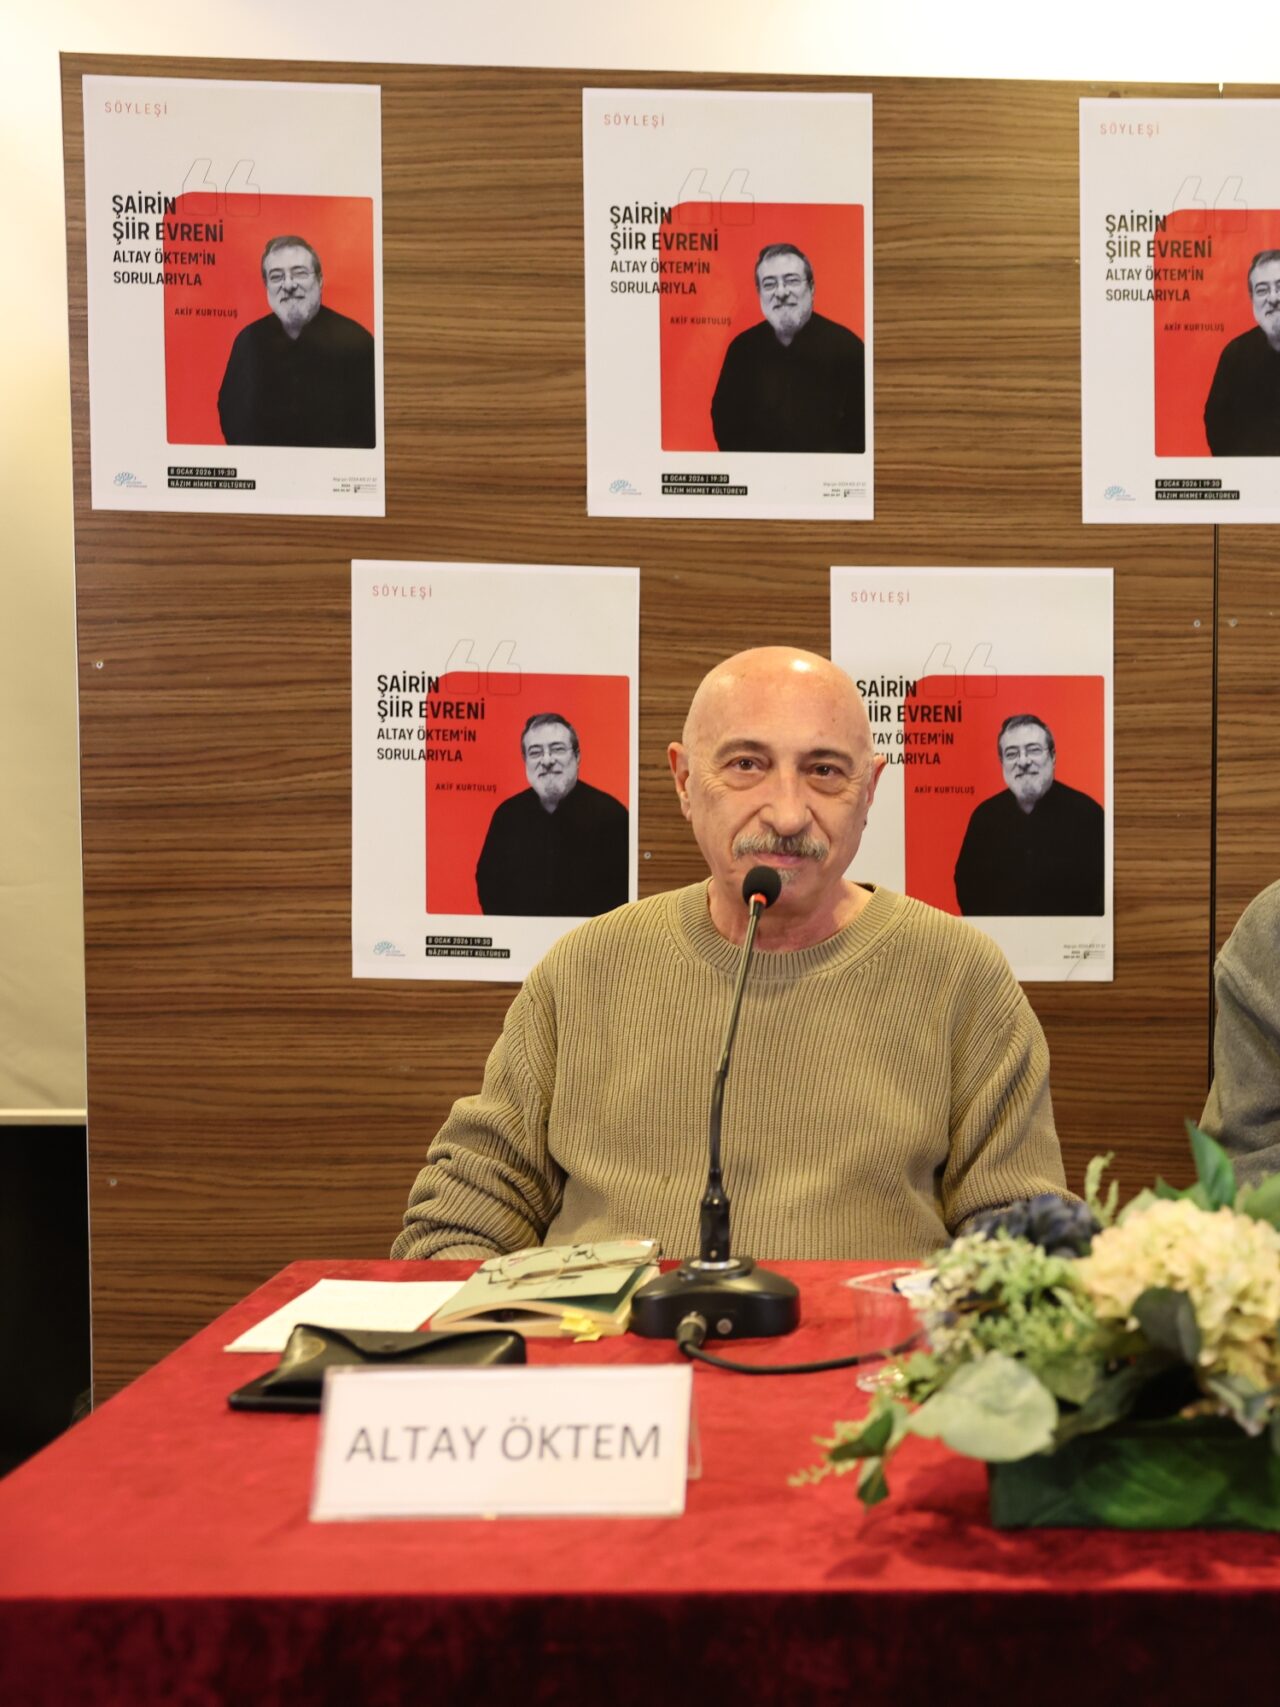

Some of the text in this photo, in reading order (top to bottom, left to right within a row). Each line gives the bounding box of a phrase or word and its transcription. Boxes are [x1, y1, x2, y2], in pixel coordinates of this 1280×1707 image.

[105, 100, 167, 118] SÖYLEŞİ
[604, 112, 664, 129] SÖYLEŞİ
[1100, 121, 1159, 138] SÖYLEŞİ
[112, 190, 176, 219] ŞAİRİN
[610, 201, 672, 230] ŞAİRİN
[1105, 209, 1167, 238] ŞAİRİN
[112, 216, 224, 245] ŞİİR EVRENİ
[610, 227, 718, 255] ŞİİR EVRENİ
[1106, 235, 1212, 264] ŞİİR EVRENİ
[113, 248, 216, 266] ALTAY ÖKTEM'İN
[610, 257, 710, 274] ALTAY ÖKTEM'İN
[113, 271, 202, 286] SORULARIYLA
[1105, 265, 1204, 281] ALTAY ÖKTEM'İN
[610, 281, 697, 294] SORULARIYLA
[1105, 289, 1191, 301] SORULARIYLA
[174, 307, 238, 319] AKİF KURTULUŞ
[669, 316, 731, 327] AKİF KURTULUŞ
[372, 584, 432, 600] SÖYLEŞİ
[850, 589, 909, 605] SÖYLEŞİ
[377, 670, 439, 698] ŞAİRİN
[377, 695, 485, 723] ŞİİR EVRENİ
[868, 700, 962, 723] İİR EVRENİ
[377, 725, 476, 742] ALTAY ÖKTEM'İN
[873, 729, 954, 745] TAY ÖKTEM'İN
[377, 747, 463, 762] SORULARIYLA
[435, 782, 497, 793] AKİF KURTULUŞ
[914, 785, 974, 795] AKİF KURTULUŞ
[345, 1417, 660, 1462] ALTAY ÖKTEM
